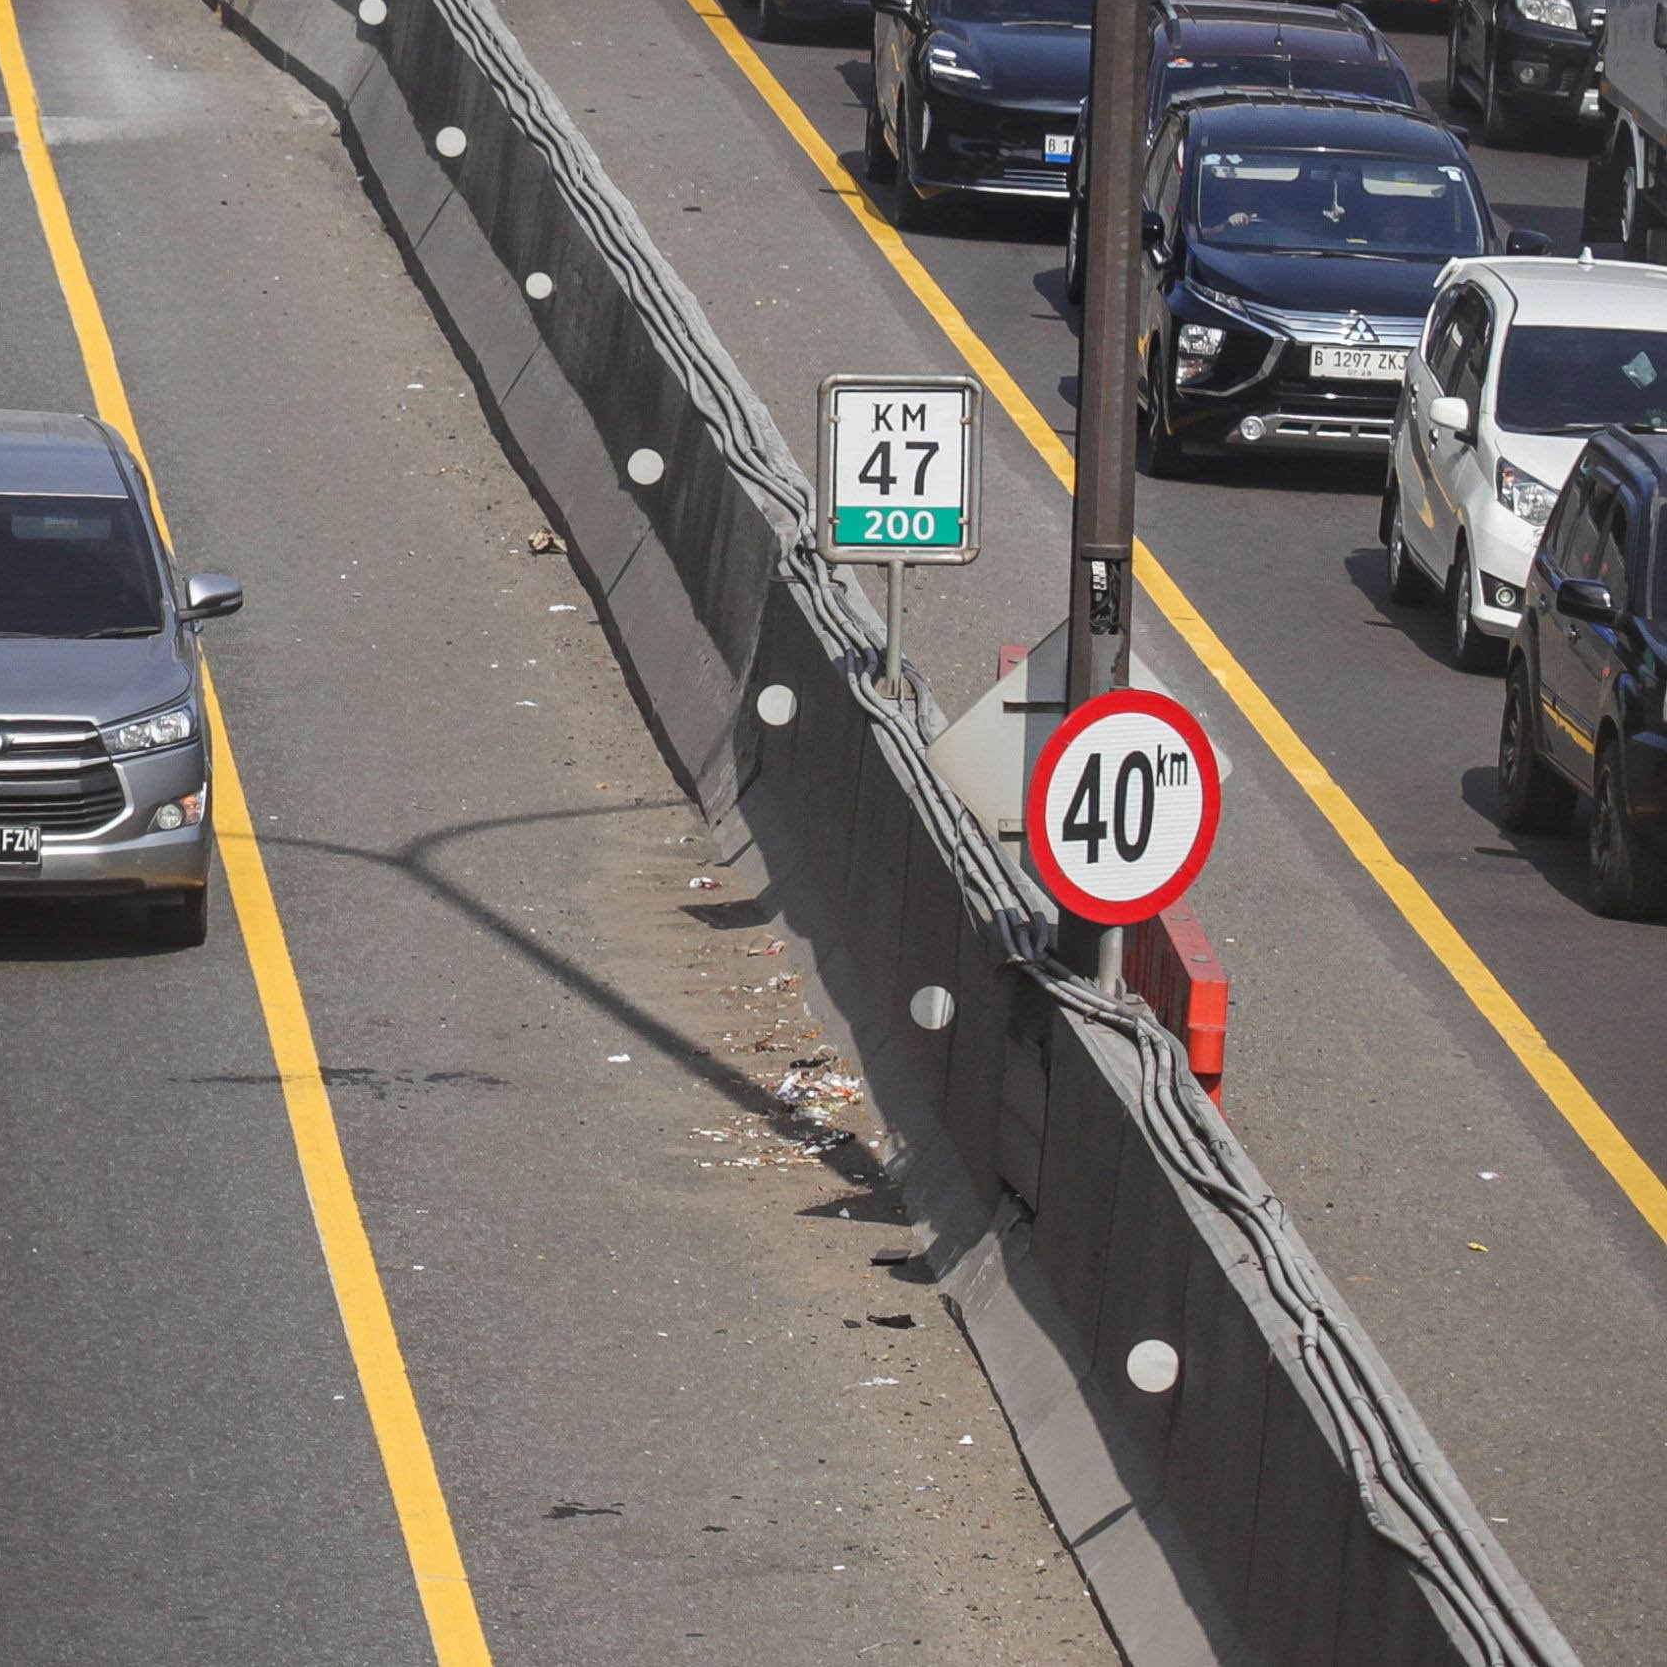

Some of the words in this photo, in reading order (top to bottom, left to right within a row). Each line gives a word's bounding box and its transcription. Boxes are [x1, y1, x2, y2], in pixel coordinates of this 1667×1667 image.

[1048, 138, 1056, 152] B
[1314, 350, 1323, 366] B
[1333, 351, 1372, 368] 1297
[871, 402, 928, 432] KM
[857, 440, 940, 496] 47
[863, 510, 935, 542] 200
[1062, 750, 1154, 865] 40
[1156, 745, 1188, 787] km
[2, 828, 39, 851] FZM
